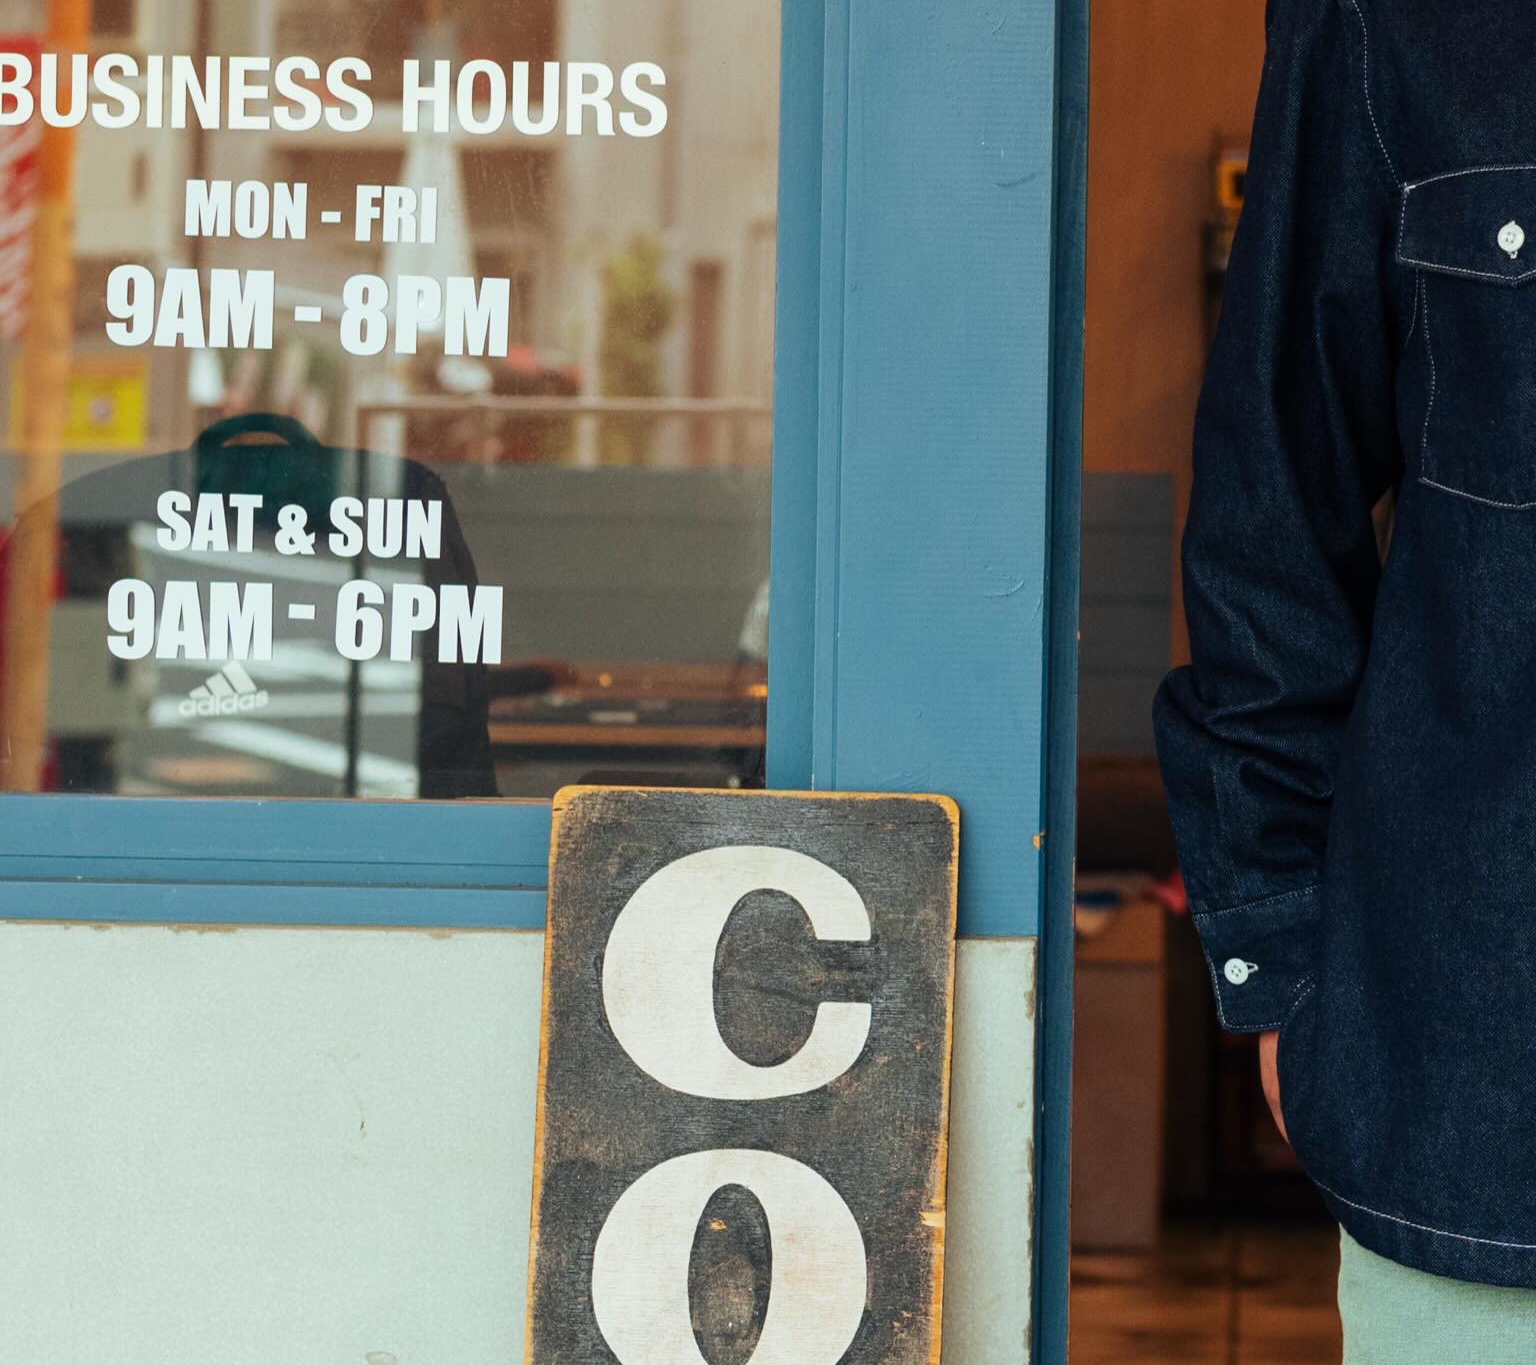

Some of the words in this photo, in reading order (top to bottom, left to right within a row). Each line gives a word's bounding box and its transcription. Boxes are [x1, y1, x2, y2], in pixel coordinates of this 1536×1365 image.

[0, 53, 374, 132] BUSINESS
[402, 59, 668, 137] HOURS
[185, 180, 307, 239] MON
[355, 185, 438, 244] FRI
[106, 265, 274, 349] 9AM
[340, 274, 511, 357] 8PM
[157, 491, 263, 552] SAT
[275, 505, 316, 555] &
[329, 497, 443, 559] SUN
[107, 579, 274, 661] 9AM
[335, 580, 504, 665] 6PM
[178, 690, 269, 718] adidas
